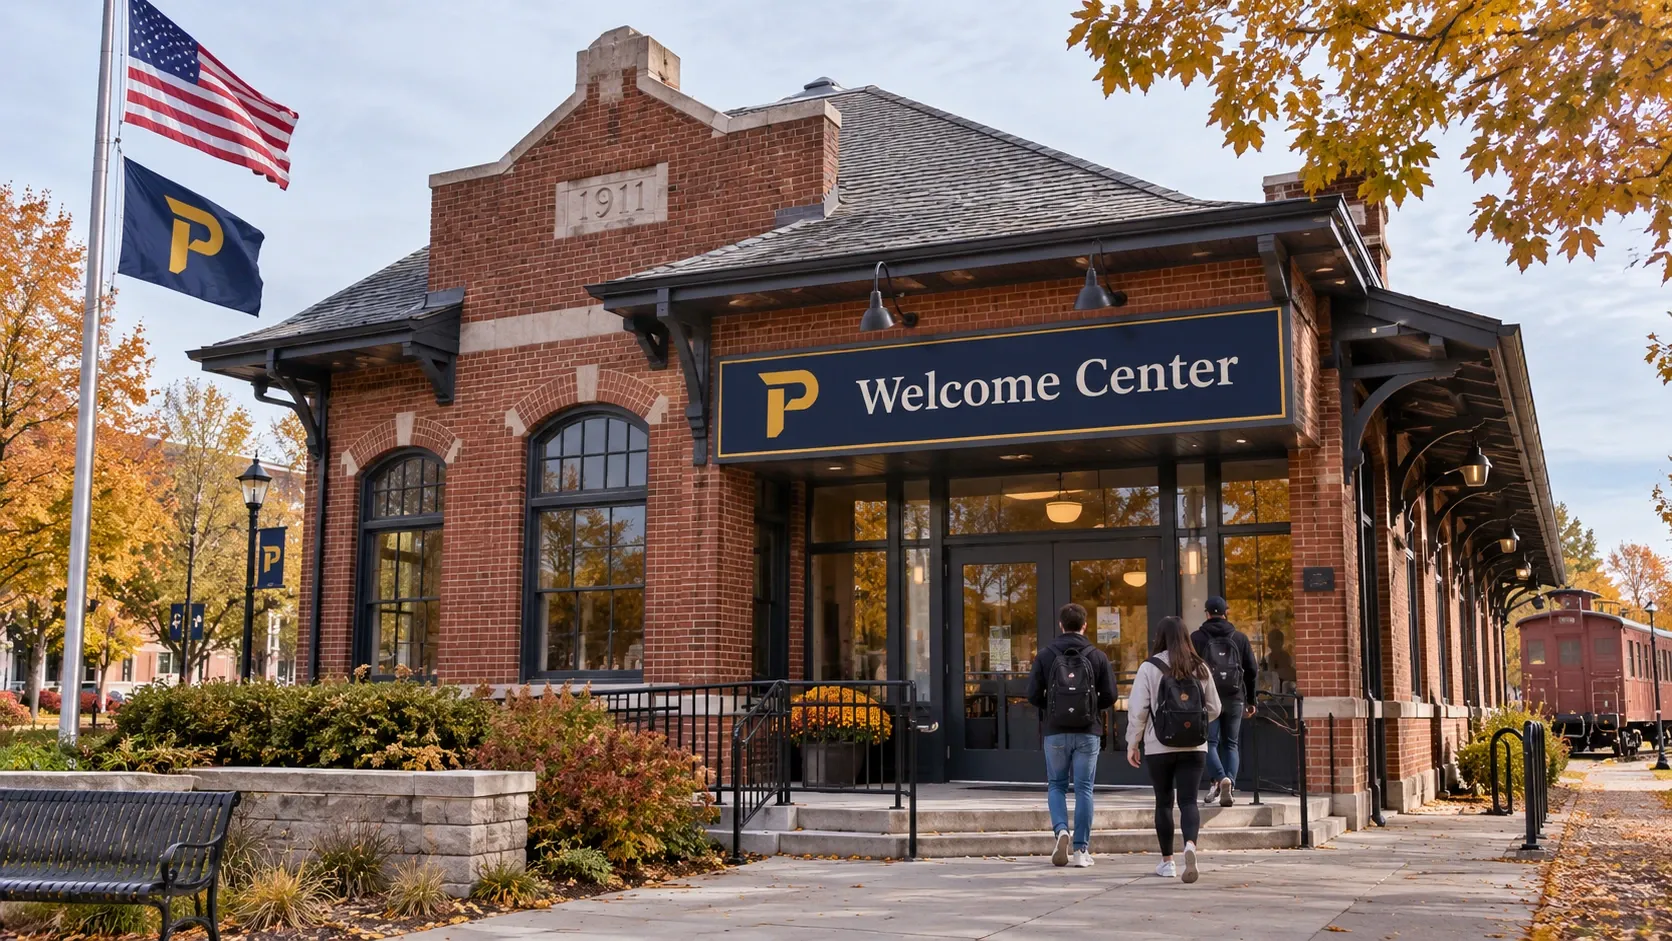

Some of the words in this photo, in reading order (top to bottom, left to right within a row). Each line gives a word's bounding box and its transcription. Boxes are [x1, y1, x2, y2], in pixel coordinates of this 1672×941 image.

[579, 181, 644, 220] 1911
[164, 194, 224, 275] P
[758, 369, 819, 438] P
[856, 370, 1060, 414] Welcome
[1076, 354, 1239, 397] Center
[262, 545, 281, 573] P
